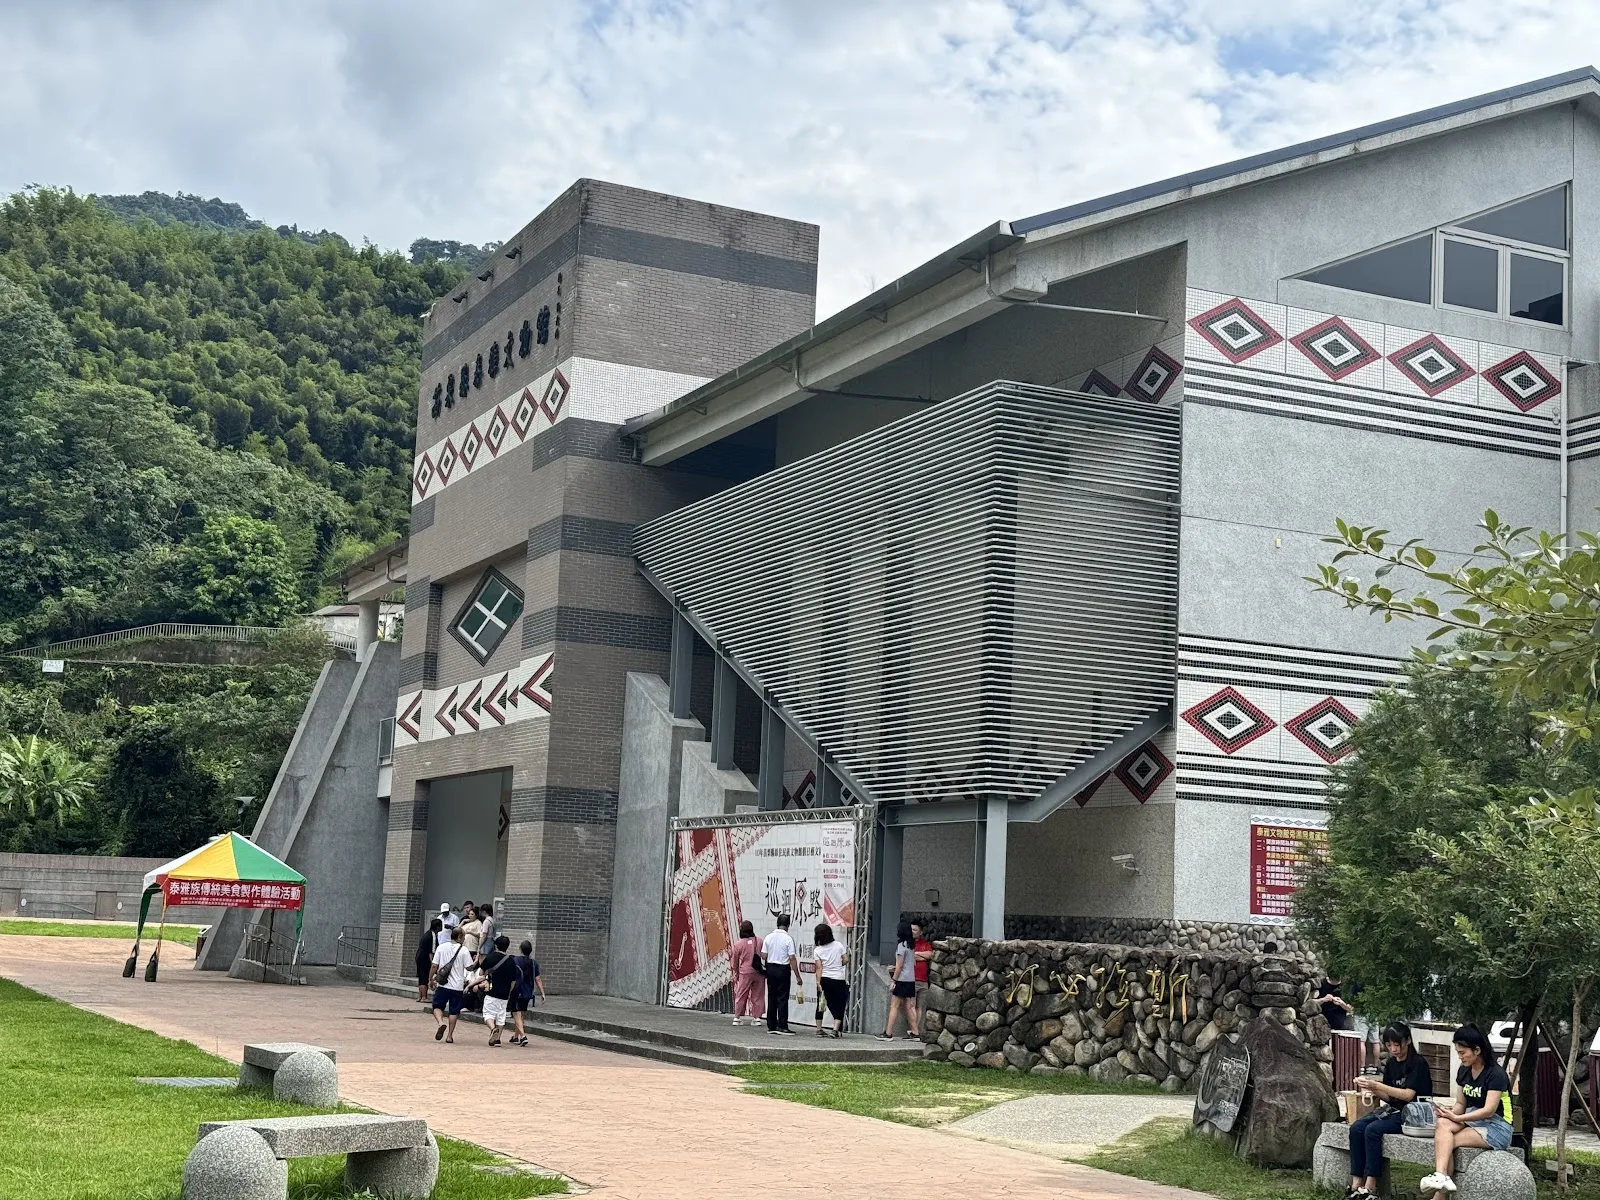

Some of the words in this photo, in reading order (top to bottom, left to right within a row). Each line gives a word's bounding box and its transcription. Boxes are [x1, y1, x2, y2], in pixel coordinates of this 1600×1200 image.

[169, 881, 301, 901] 泰雅族傳統美食製作體驗活動
